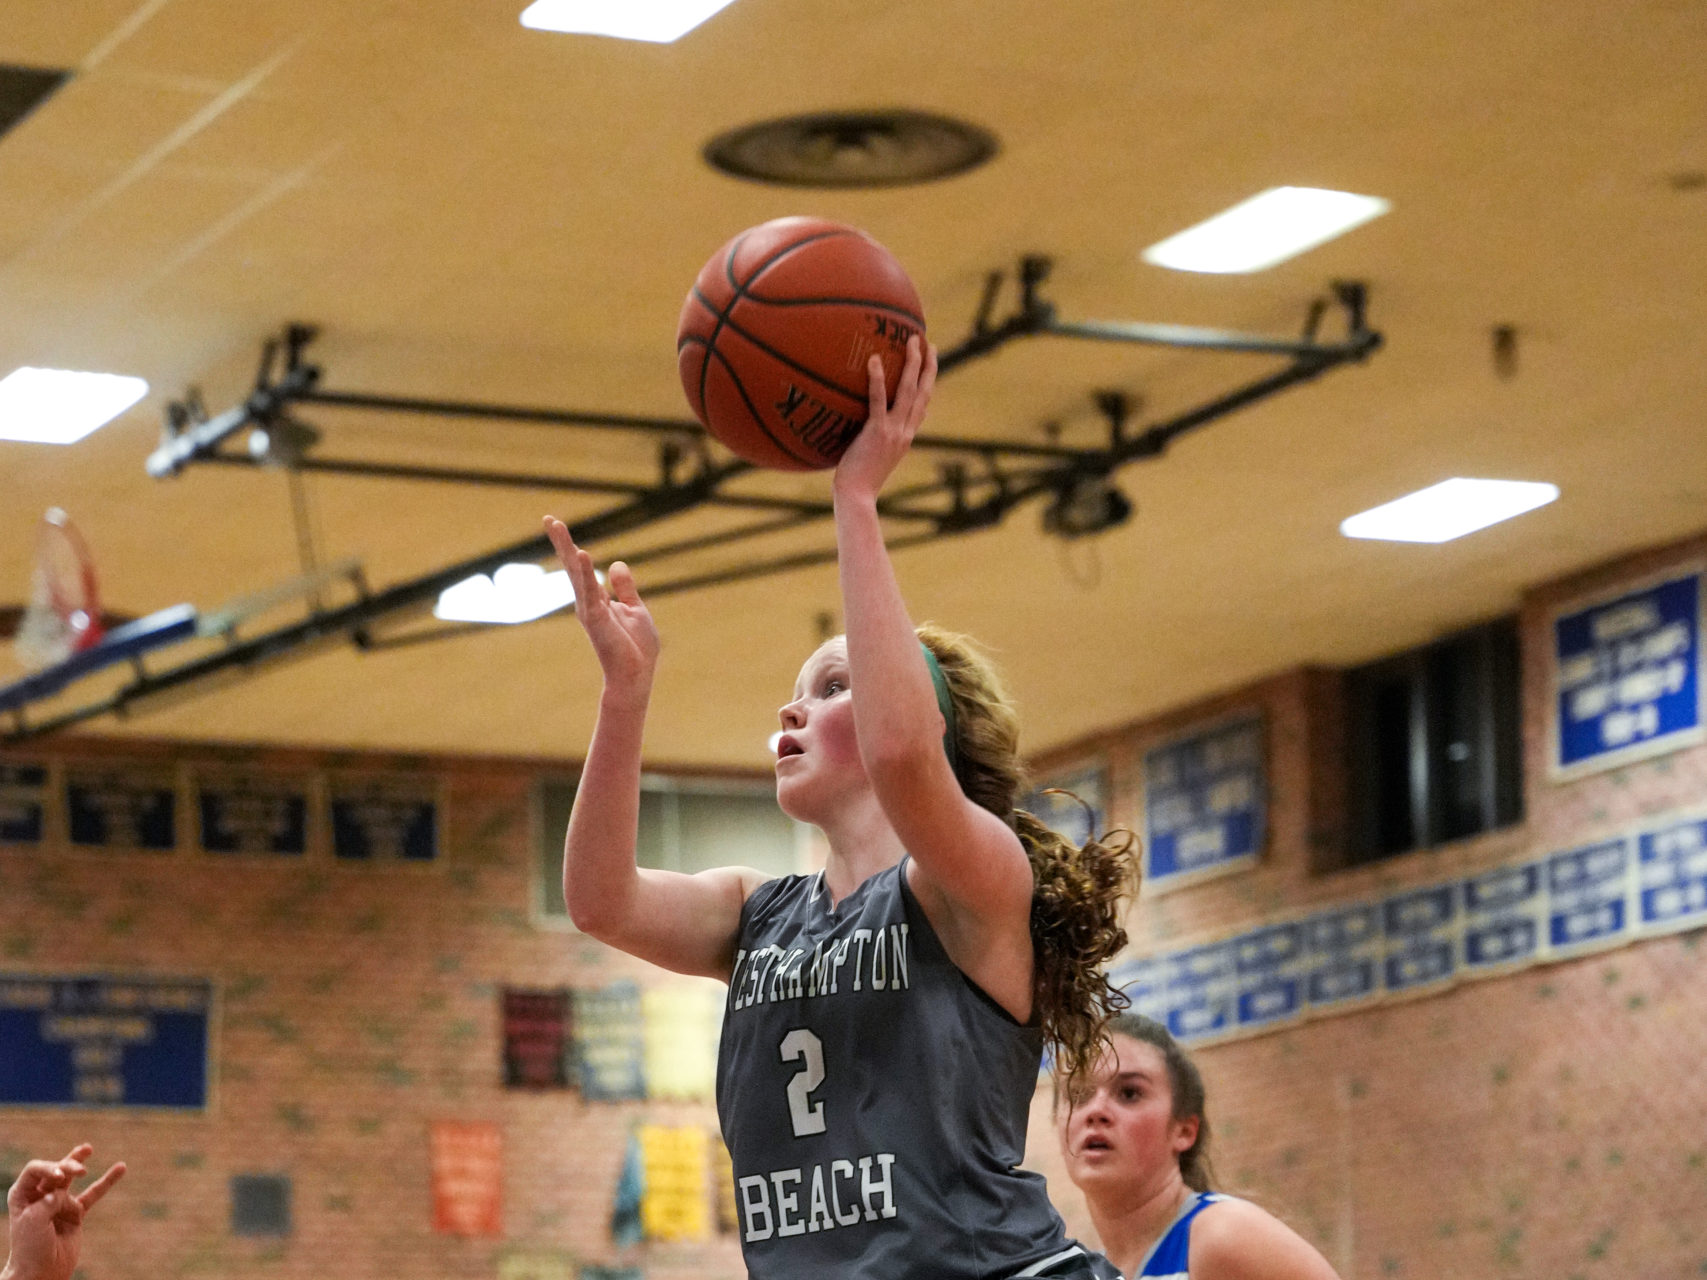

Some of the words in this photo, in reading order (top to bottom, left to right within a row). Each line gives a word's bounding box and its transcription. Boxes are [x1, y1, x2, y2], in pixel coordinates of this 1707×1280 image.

[873, 313, 919, 345] OCK
[729, 923, 908, 1011] ESTHAMPTON
[779, 1028, 827, 1137] 2
[739, 1153, 897, 1243] BEACH
